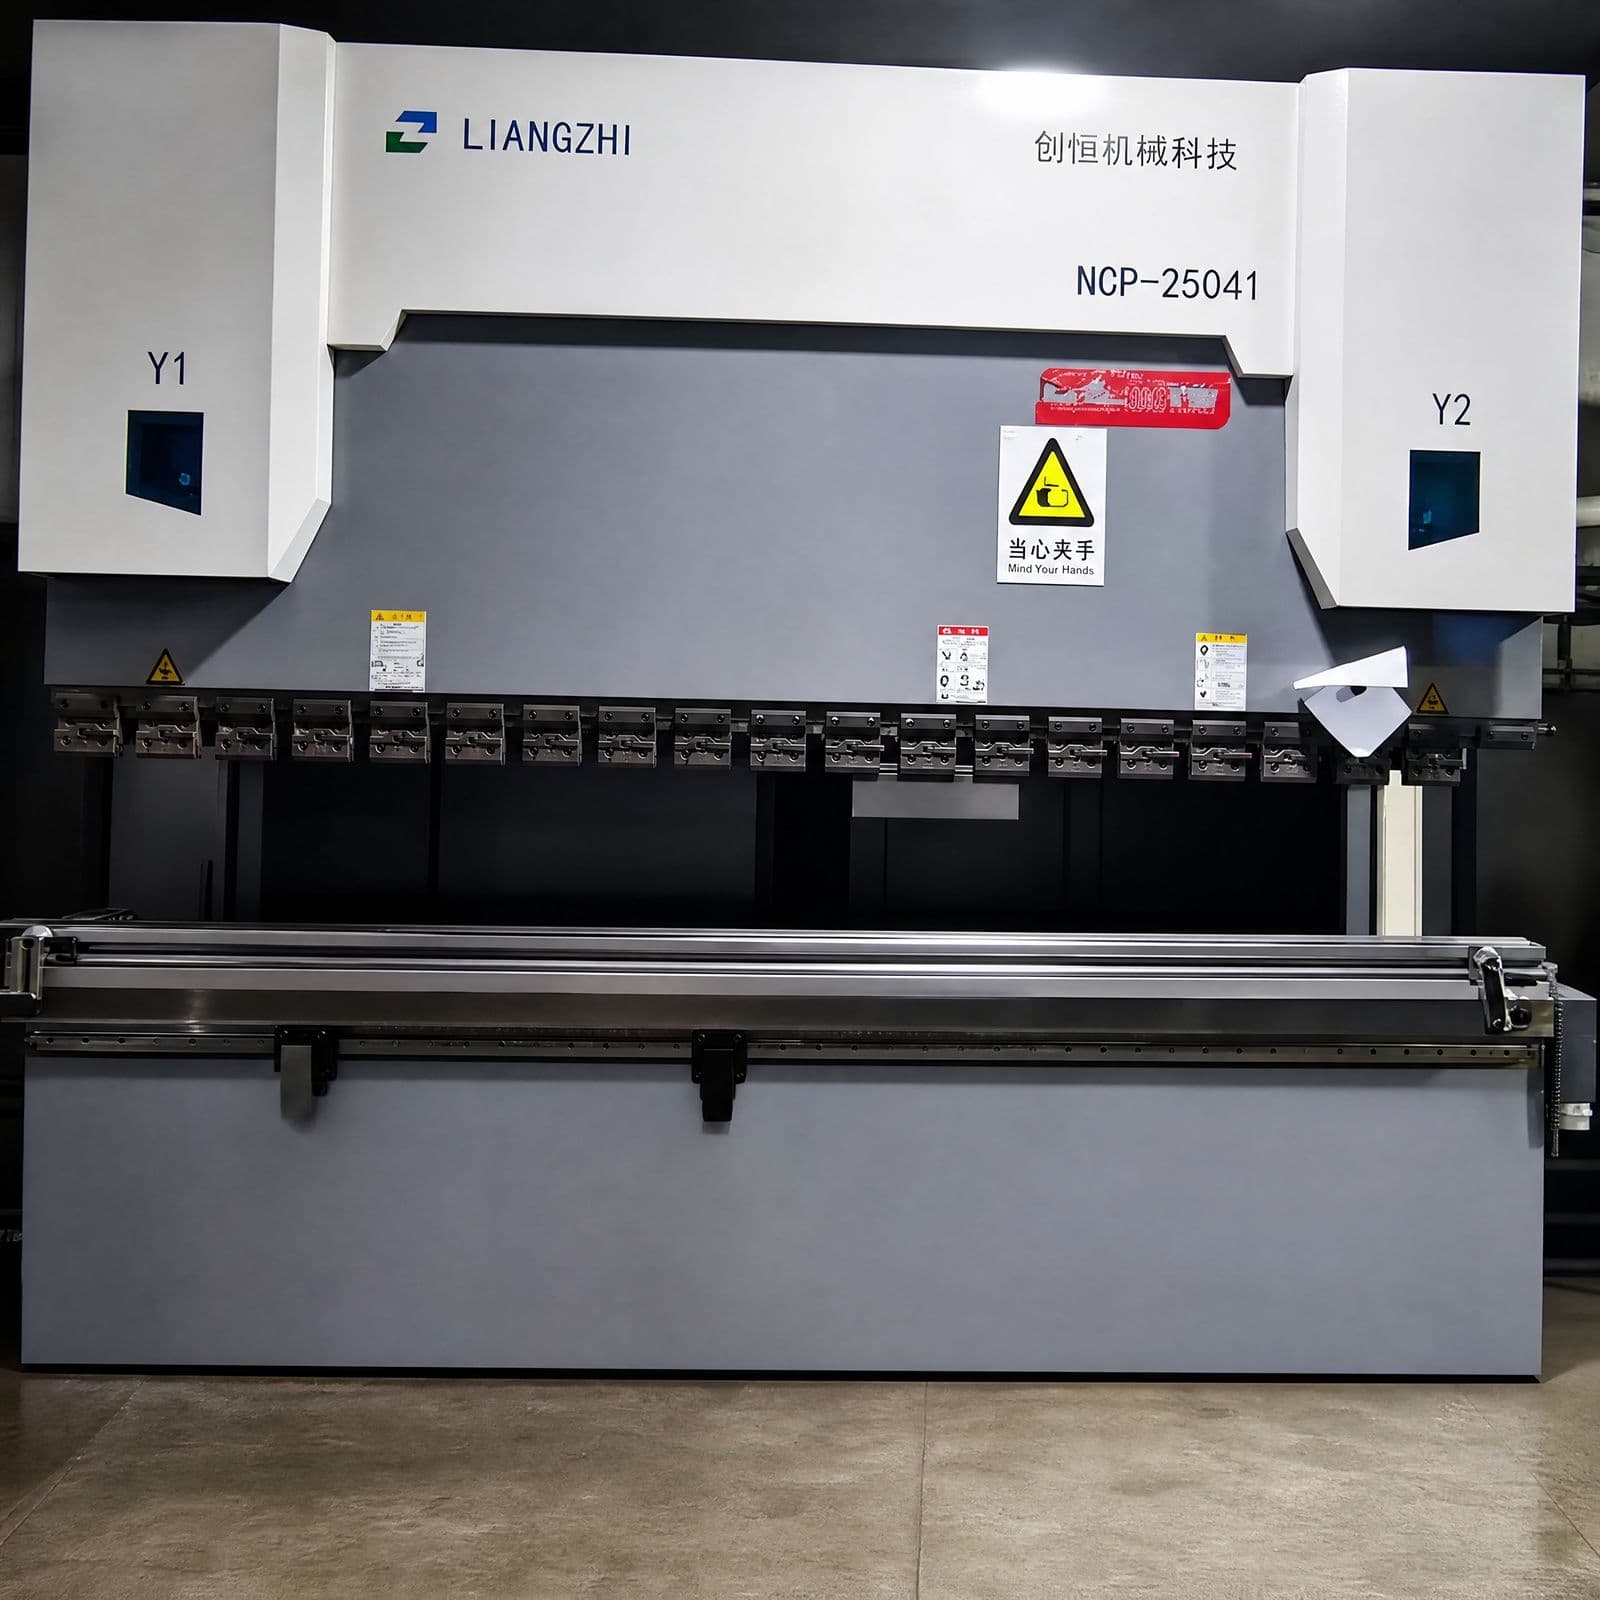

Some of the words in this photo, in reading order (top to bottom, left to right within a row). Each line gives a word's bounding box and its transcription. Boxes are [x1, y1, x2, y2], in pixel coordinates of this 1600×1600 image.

[463, 117, 630, 156] LIANGZHI
[1034, 130, 1238, 171] 创恒机械科技
[1077, 265, 1257, 301] NCP-25041
[147, 351, 186, 386] Y1
[1432, 392, 1471, 426] Y2
[1009, 537, 1095, 562] 当心夹手
[1008, 563, 1033, 574] Mind
[1035, 564, 1059, 575] Your
[1062, 565, 1095, 576] Hands
